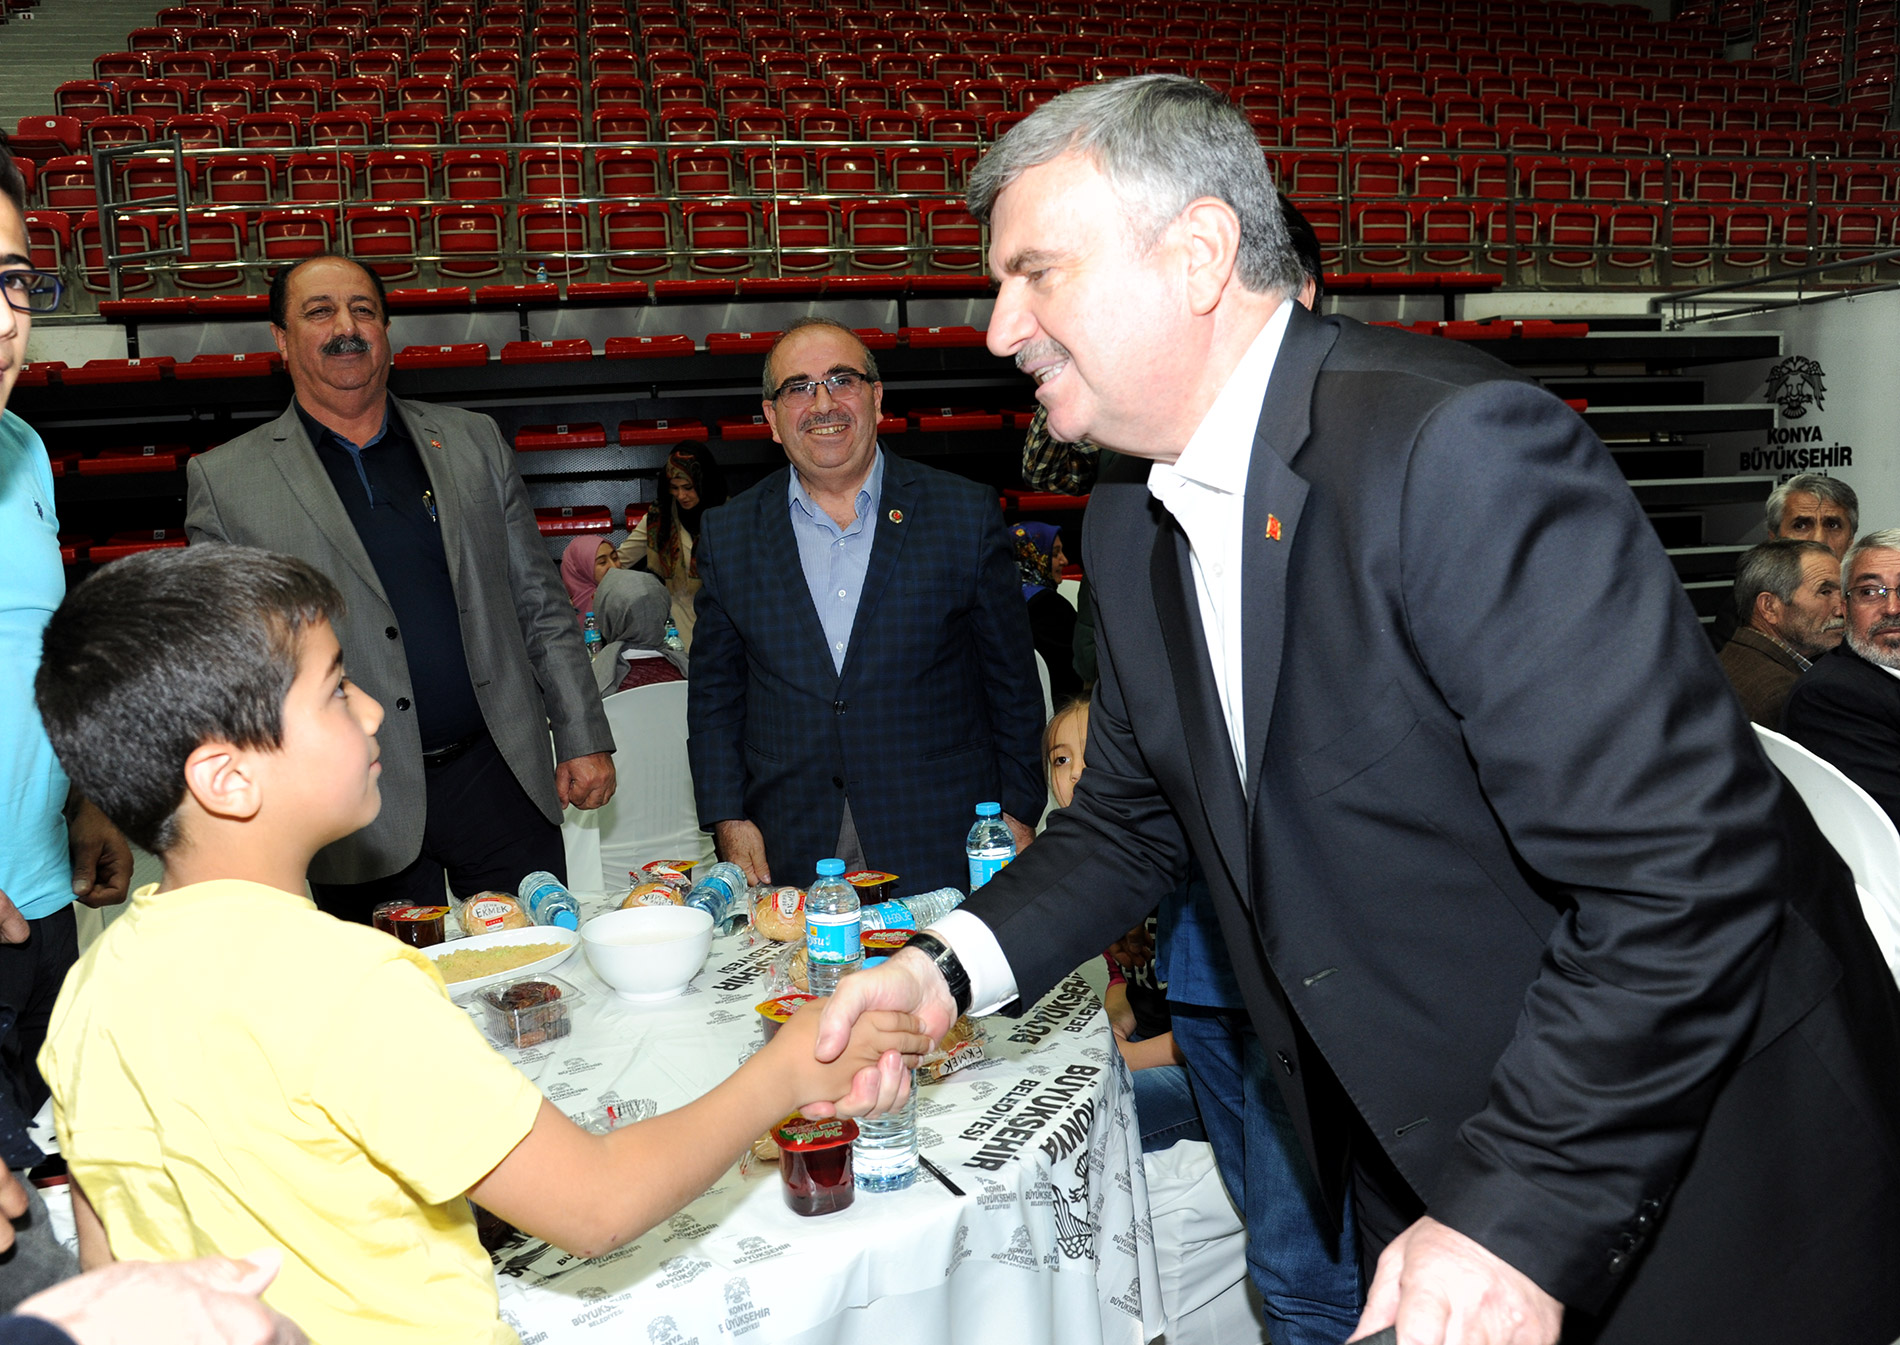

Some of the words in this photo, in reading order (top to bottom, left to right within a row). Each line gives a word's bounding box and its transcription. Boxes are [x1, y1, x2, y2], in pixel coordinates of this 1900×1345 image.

[1767, 425, 1823, 445] KONYA
[1740, 442, 1852, 471] BÜYÜKŞEHİR
[475, 905, 509, 918] EKMEK
[716, 939, 786, 975] ELEDİYESİ
[944, 1046, 983, 1073] EKMEK
[959, 1079, 1041, 1142] BELEDİYESİ
[962, 1065, 1101, 1171] BÜYÜKŞEHİR
[976, 1190, 1018, 1206] BÜYÜKŞEHİR
[984, 1184, 1006, 1193] KONYA
[728, 1300, 755, 1316] KONYA
